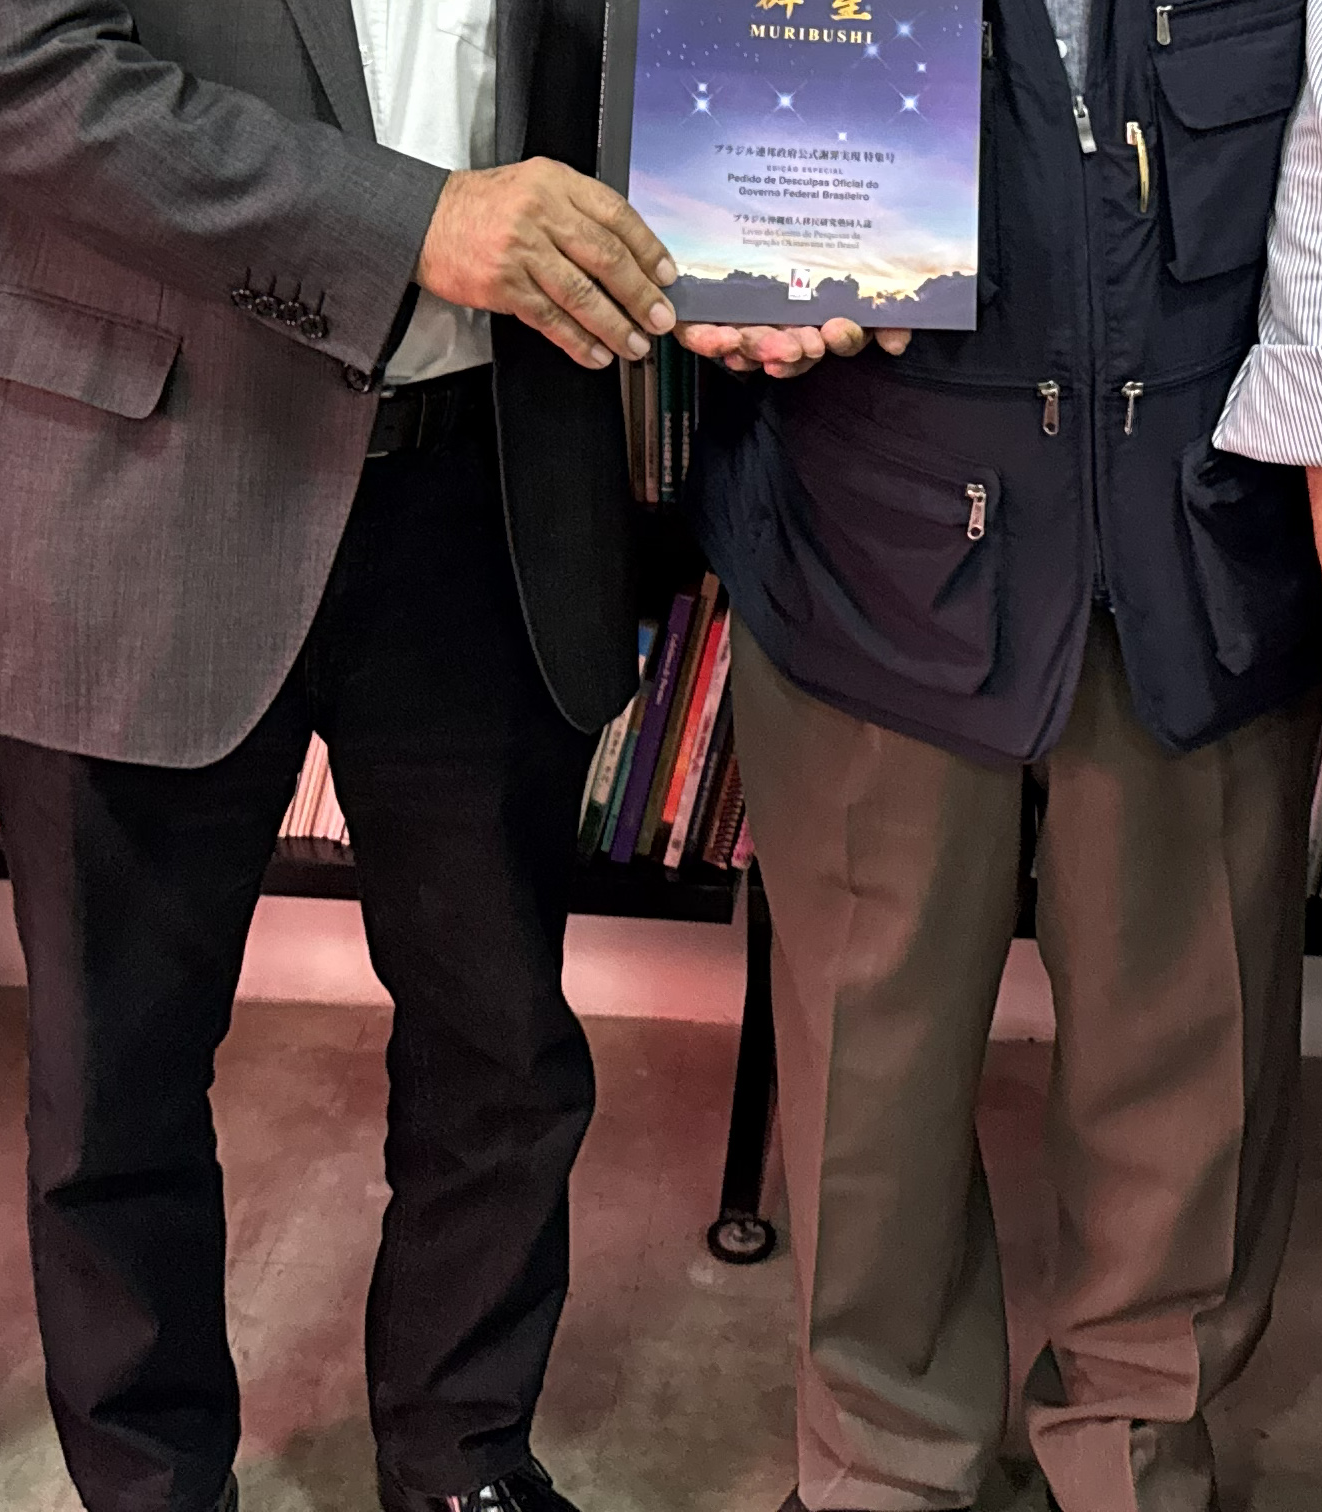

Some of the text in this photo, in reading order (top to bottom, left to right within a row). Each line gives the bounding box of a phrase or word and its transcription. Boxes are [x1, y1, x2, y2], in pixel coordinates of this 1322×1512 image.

[749, 23, 874, 45] MURIBUSHI
[766, 164, 844, 175] EDIÇÃO ESPECIAL
[728, 173, 879, 189] Pedido de Desculpas Oficial do
[738, 186, 870, 201] Governo Federal Brasileiro
[836, 240, 860, 249] Brasil
